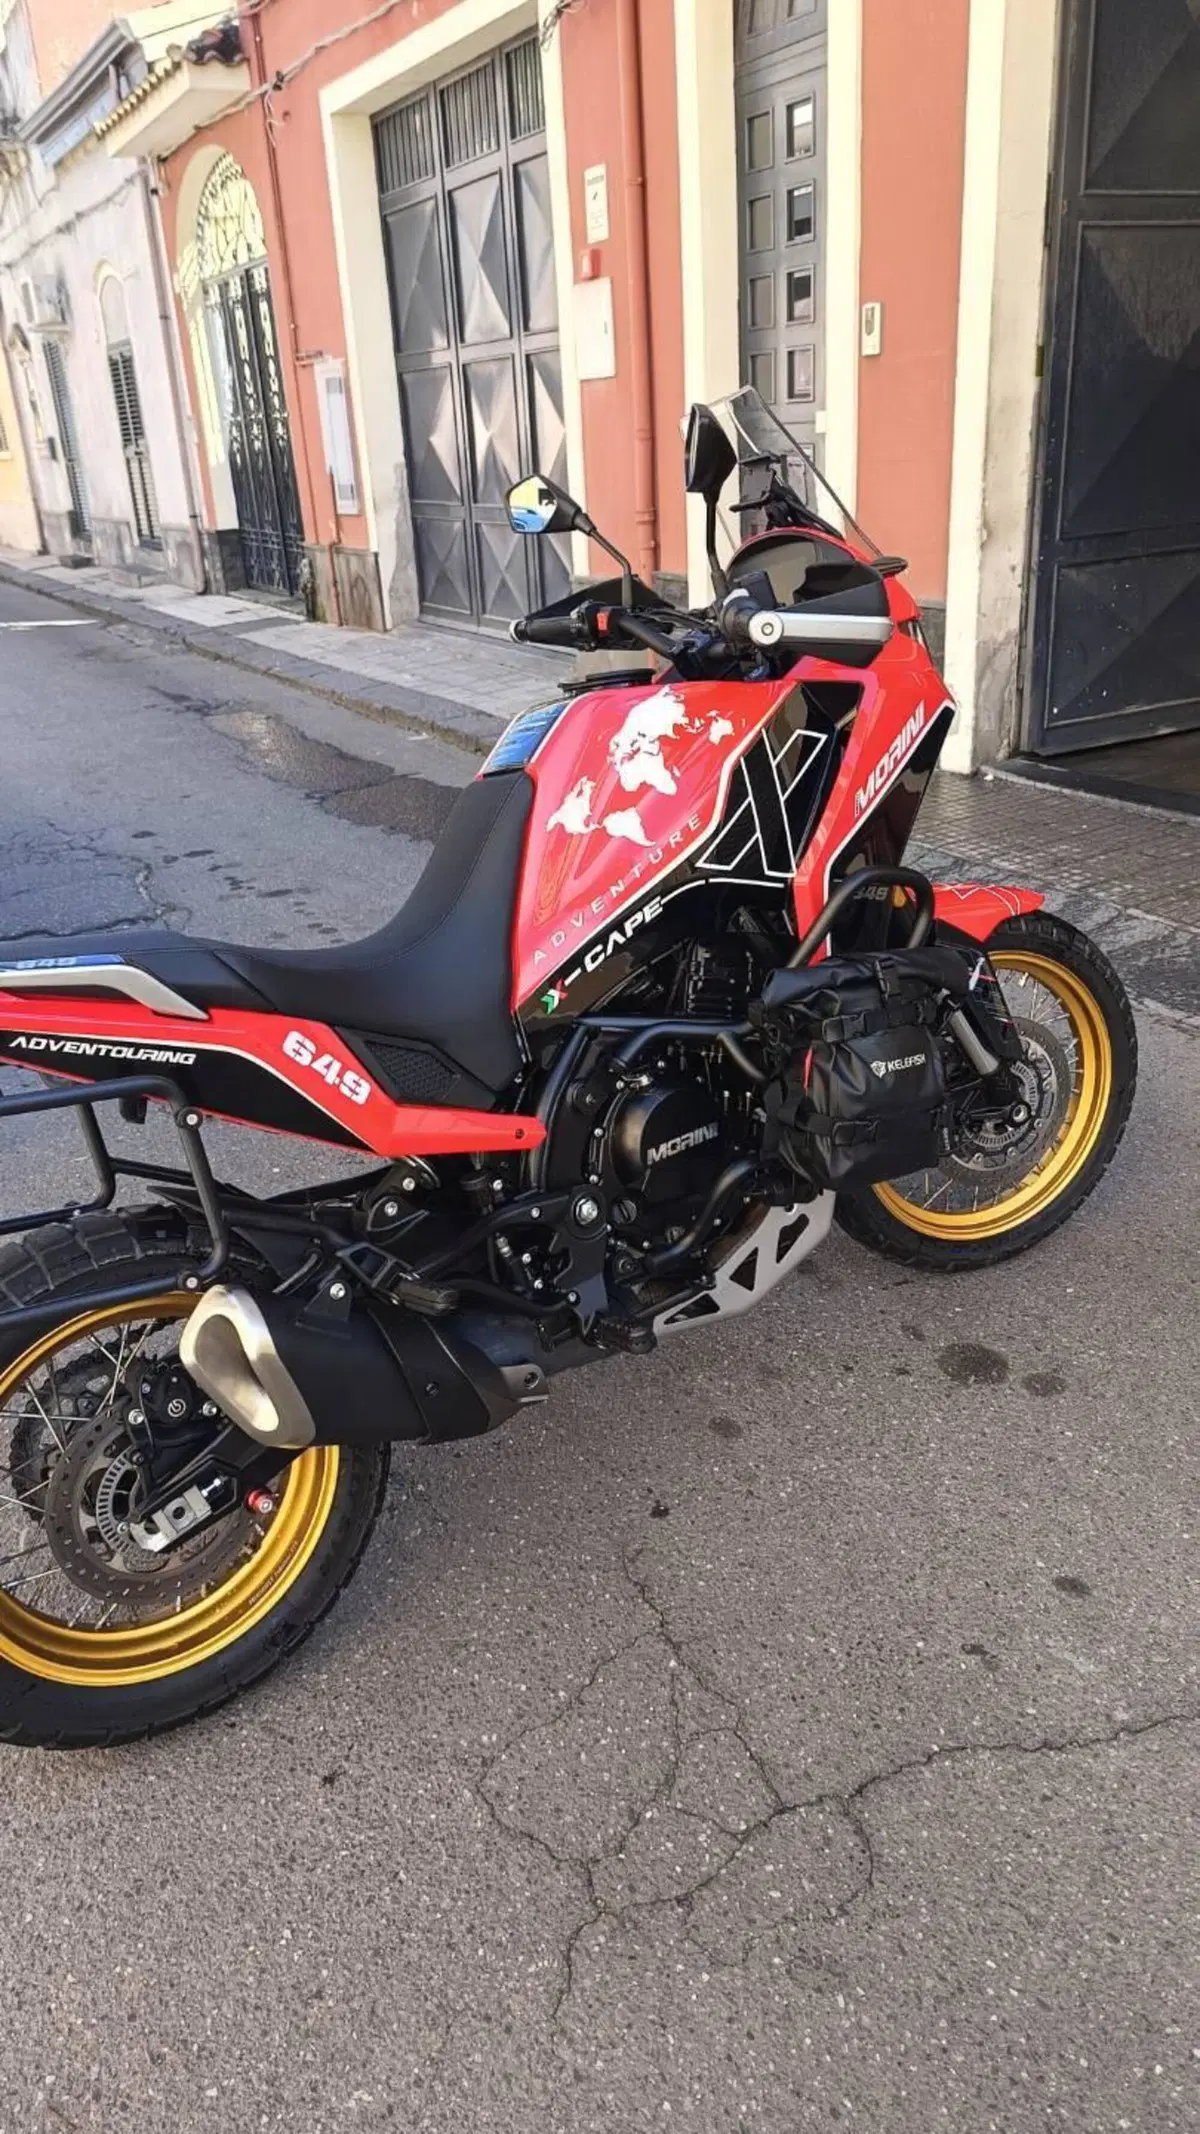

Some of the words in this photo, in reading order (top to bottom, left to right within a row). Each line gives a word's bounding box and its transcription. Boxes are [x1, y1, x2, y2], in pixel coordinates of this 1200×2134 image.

[854, 699, 925, 818] MORINI
[533, 813, 701, 966] ADVENTURE
[541, 895, 663, 1014] X-CAPE
[9, 1036, 197, 1065] ADVENTOURING
[282, 1030, 372, 1105] 649
[647, 1121, 719, 1165] MORINI
